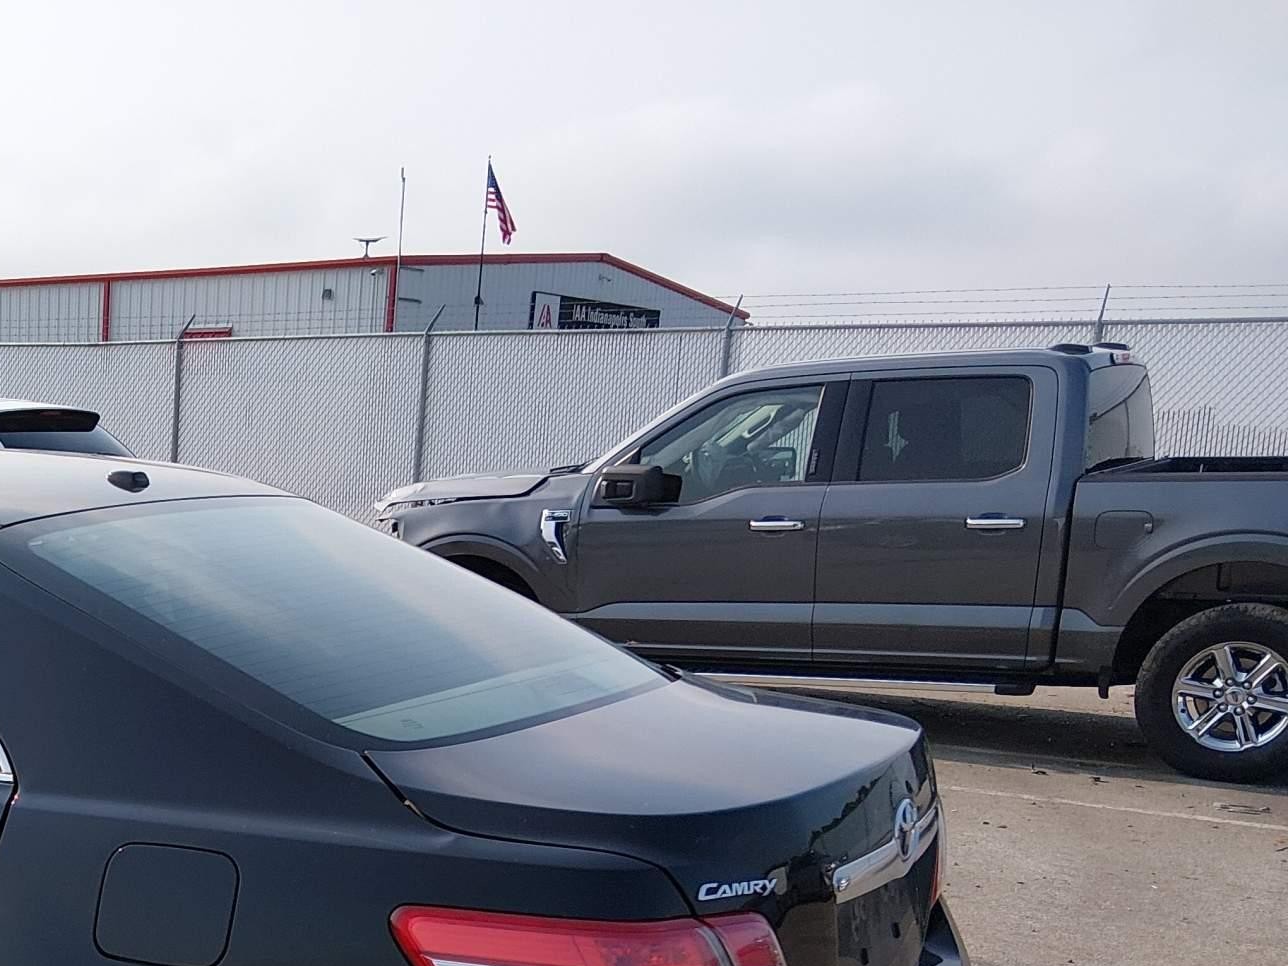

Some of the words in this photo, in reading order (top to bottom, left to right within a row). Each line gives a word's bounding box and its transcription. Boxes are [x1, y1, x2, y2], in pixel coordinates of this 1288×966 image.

[572, 304, 586, 321] IAA
[587, 306, 628, 326] Indianapolis
[698, 879, 777, 901] CAMRY
